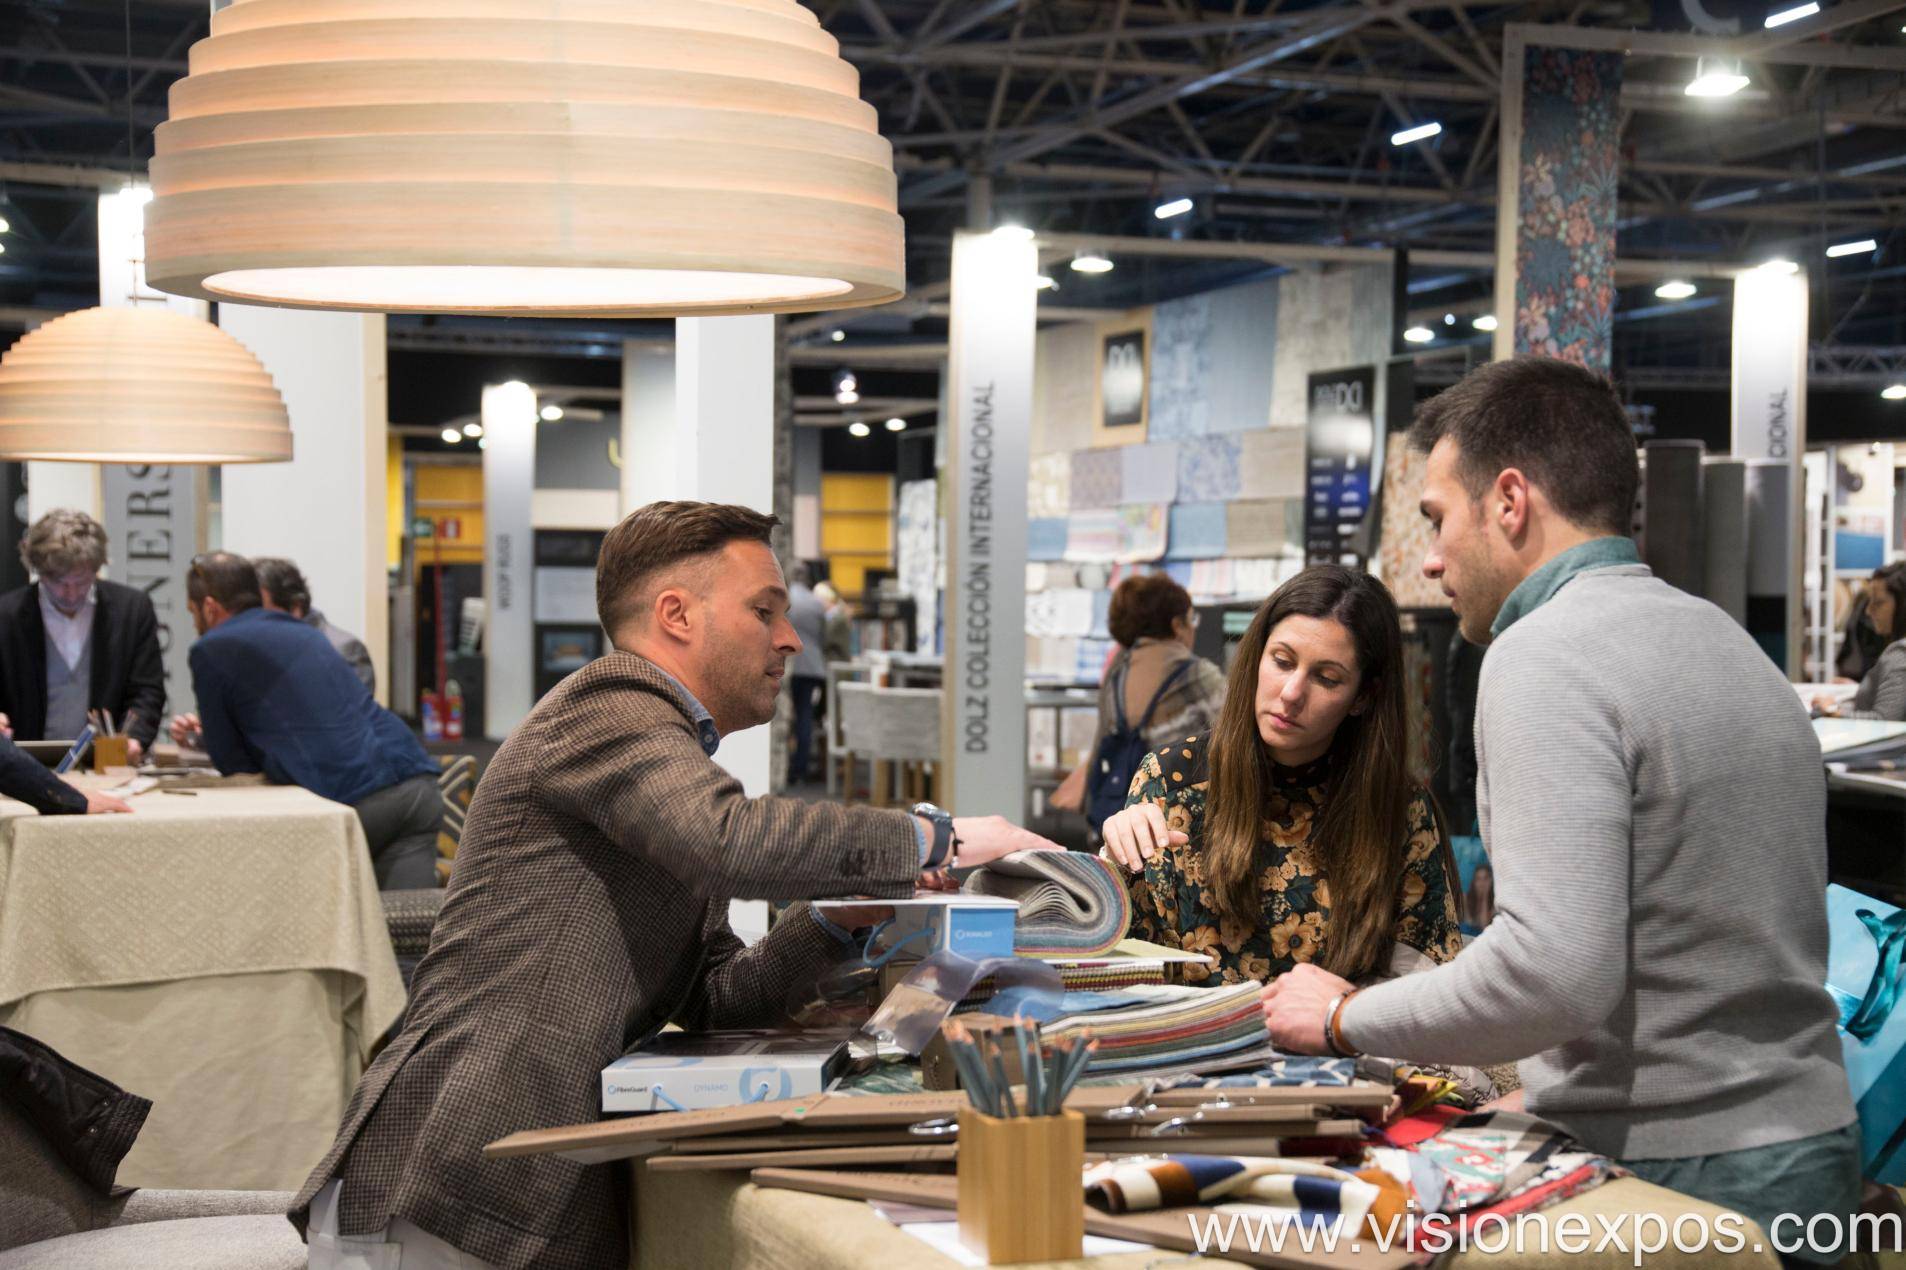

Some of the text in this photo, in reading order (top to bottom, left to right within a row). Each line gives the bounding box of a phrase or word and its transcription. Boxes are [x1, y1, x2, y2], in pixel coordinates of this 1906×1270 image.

[1768, 386, 1787, 457] CIONAL
[126, 463, 171, 680] NERS
[964, 380, 994, 752] DOLZ COLECCIÓN INTERNACIONAL
